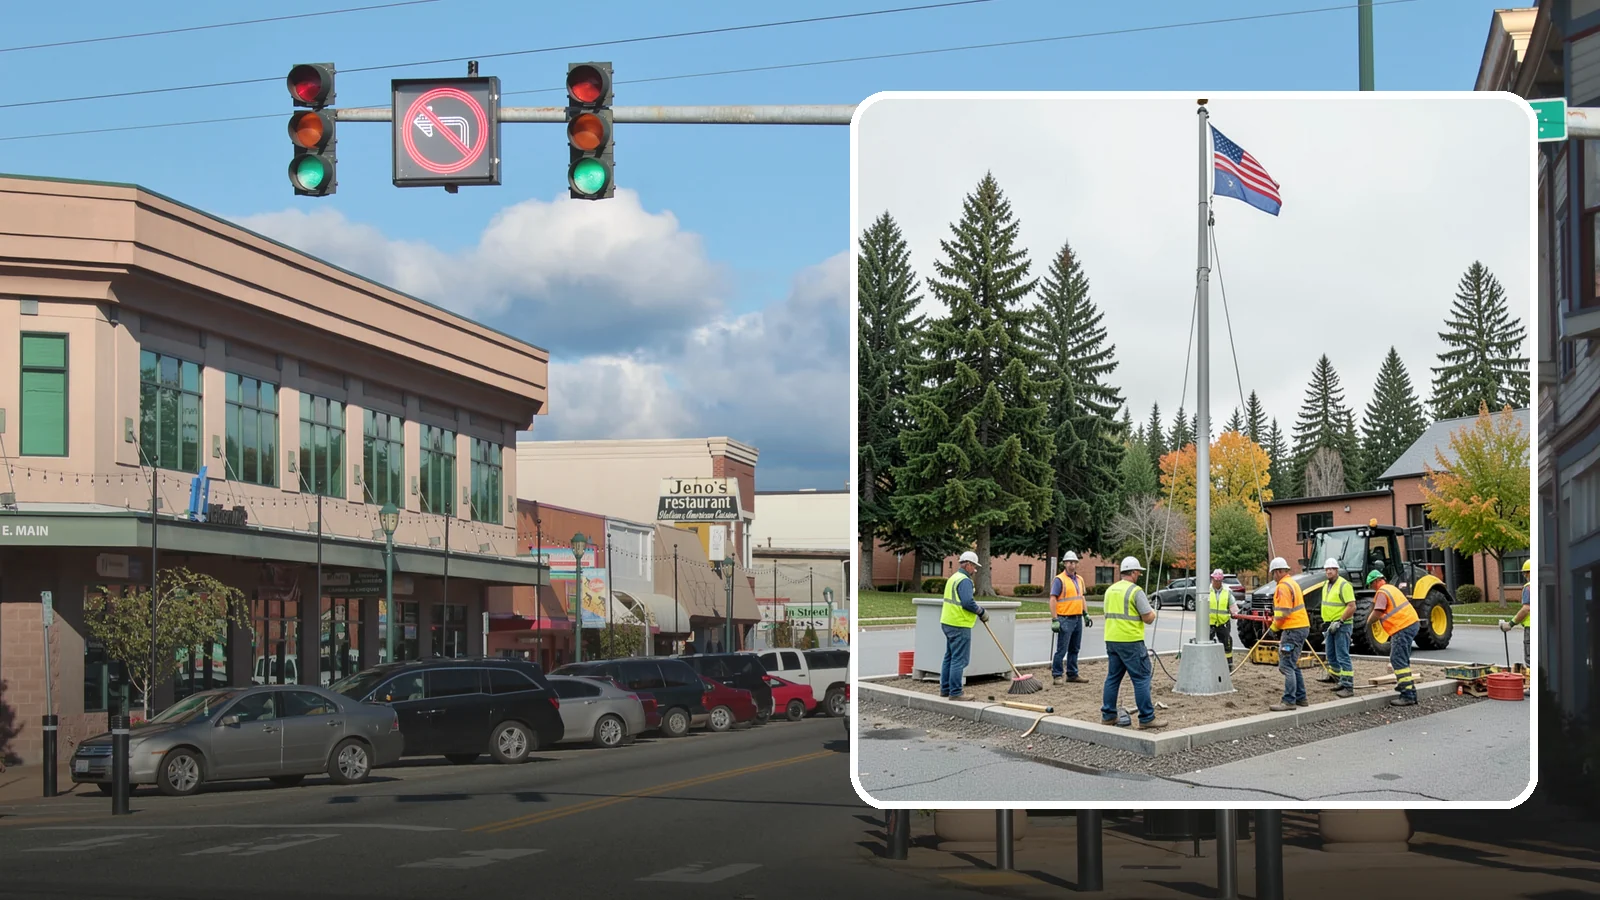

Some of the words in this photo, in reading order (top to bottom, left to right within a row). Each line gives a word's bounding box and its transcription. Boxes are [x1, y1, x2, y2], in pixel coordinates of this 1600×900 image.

[669, 480, 728, 495] Jeno's
[665, 496, 731, 509] restaurant
[658, 510, 681, 520] Italian
[685, 509, 715, 519] American
[715, 509, 738, 519] Cuisine
[2, 525, 13, 536] E.
[15, 525, 49, 536] MAIN
[797, 607, 828, 617] Street
[791, 619, 824, 627] lass
